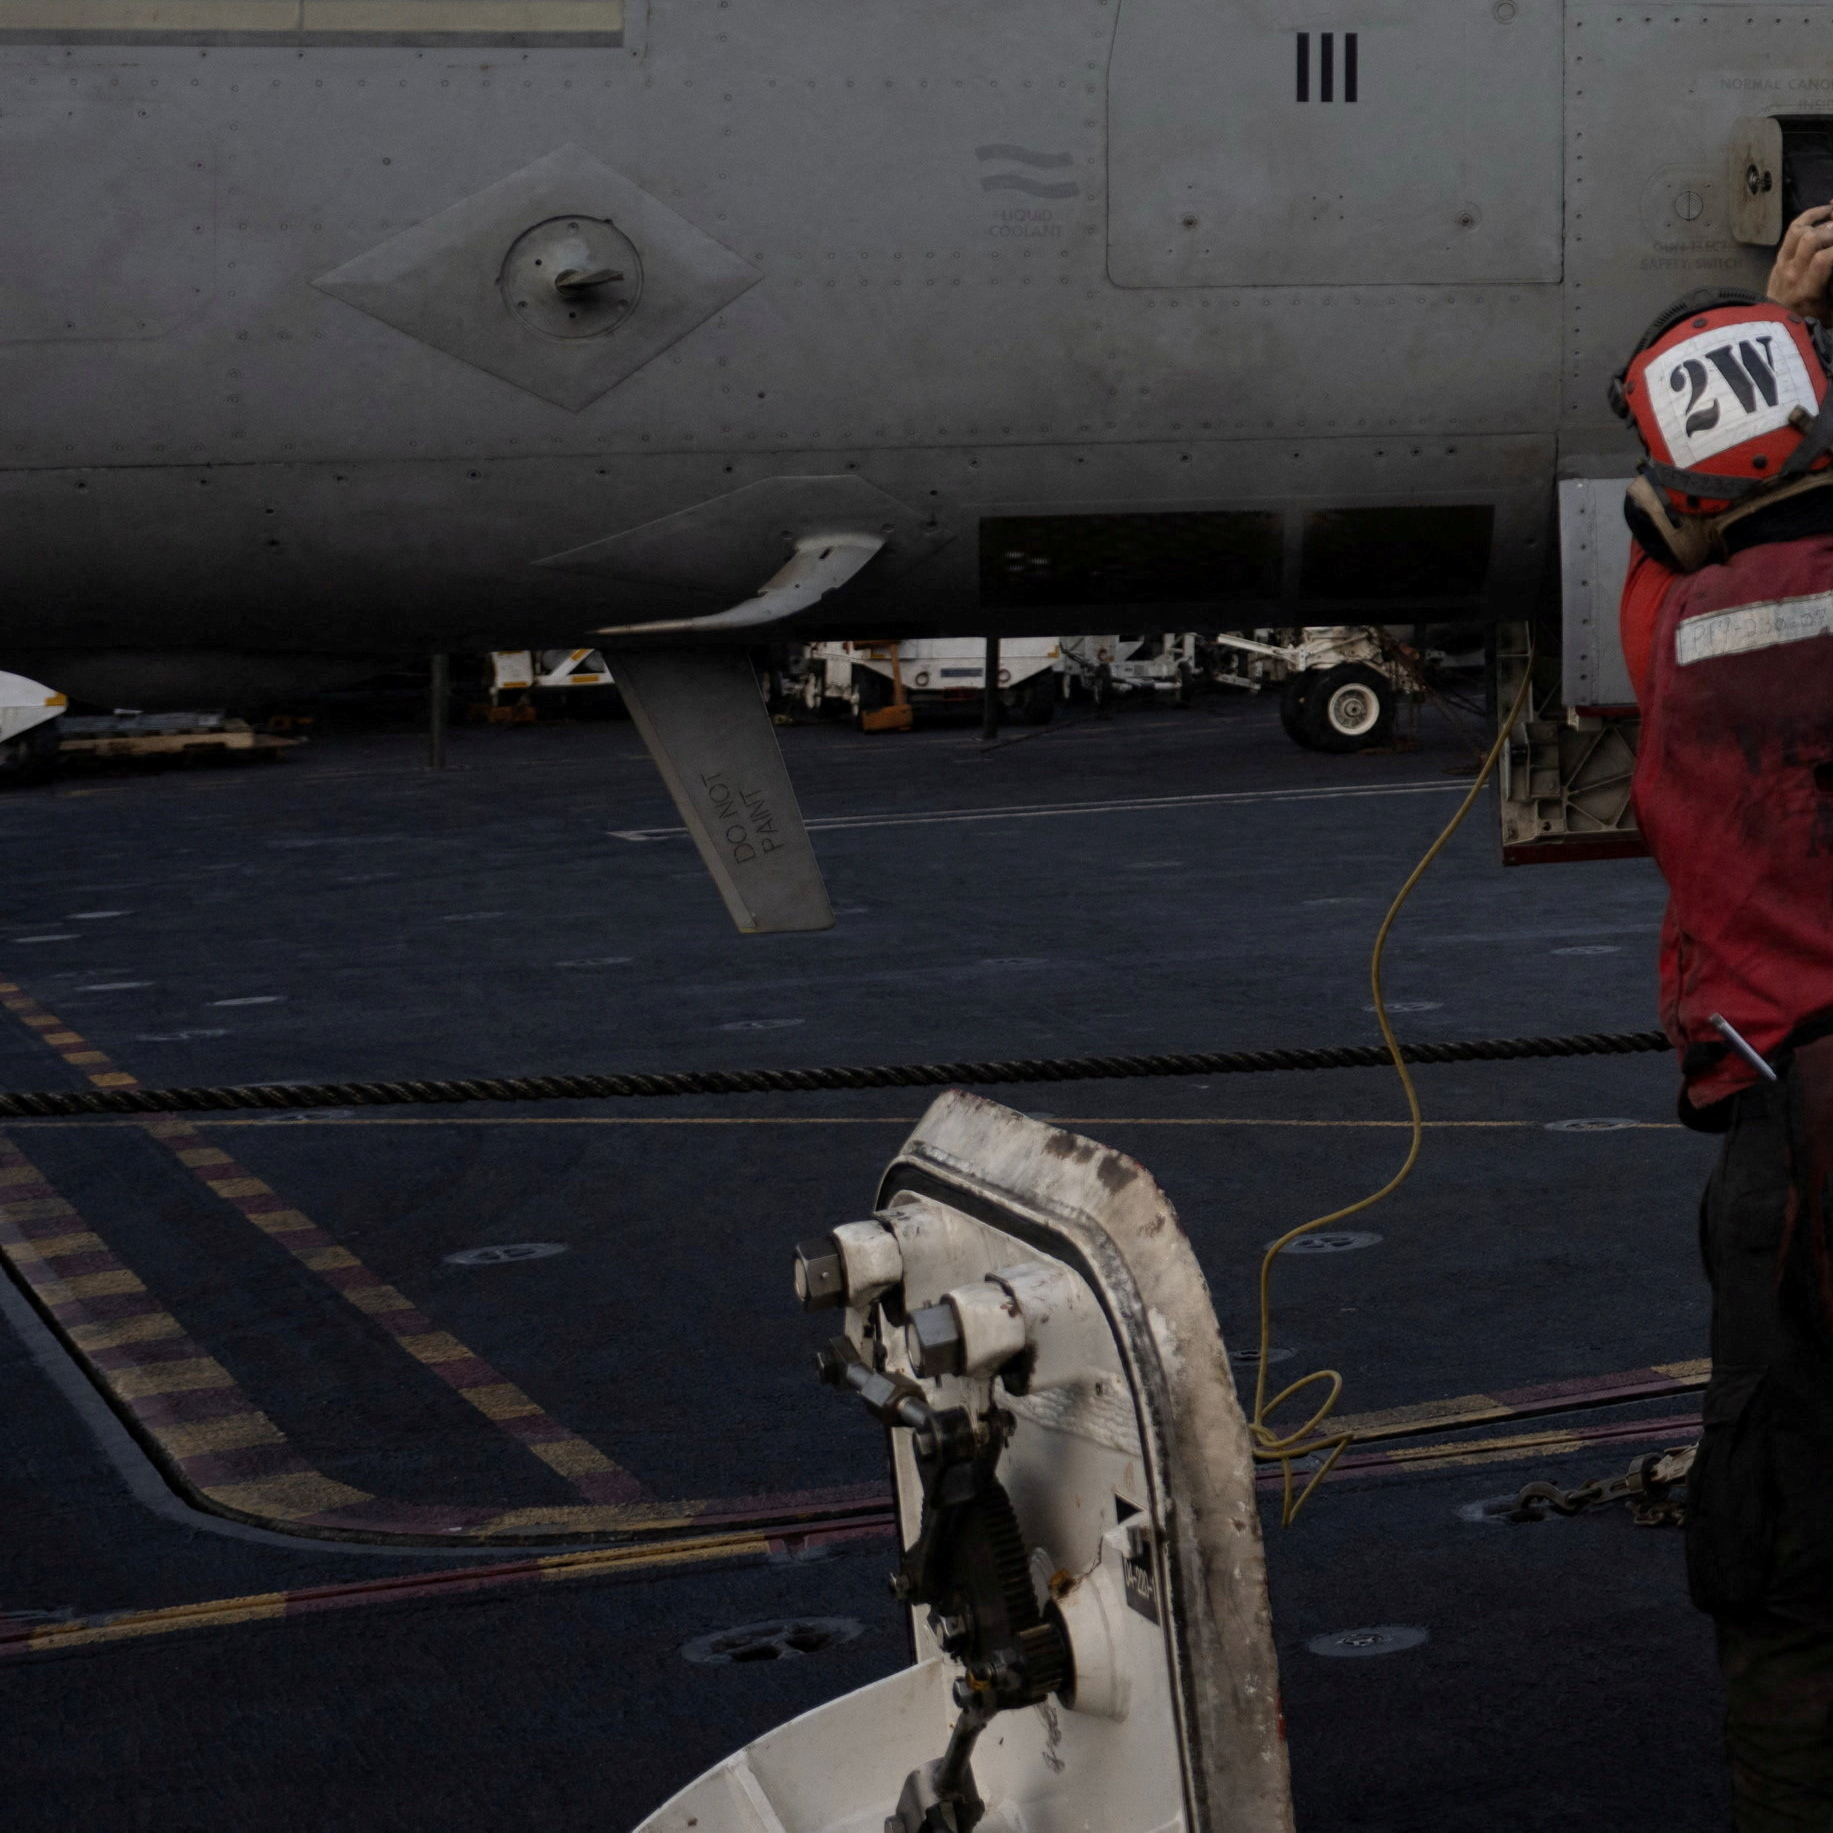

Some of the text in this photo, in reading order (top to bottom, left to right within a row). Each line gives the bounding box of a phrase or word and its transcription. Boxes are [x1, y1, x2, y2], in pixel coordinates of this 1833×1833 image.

[1719, 77, 1782, 91] NORMAL
[1001, 208, 1053, 222] LIQUID
[988, 225, 1064, 238] COOLANT
[1640, 257, 1743, 270] SAFETY SWITCH
[1670, 336, 1778, 438] 2W
[700, 774, 756, 864] DO NOT
[739, 789, 785, 853] PAINT
